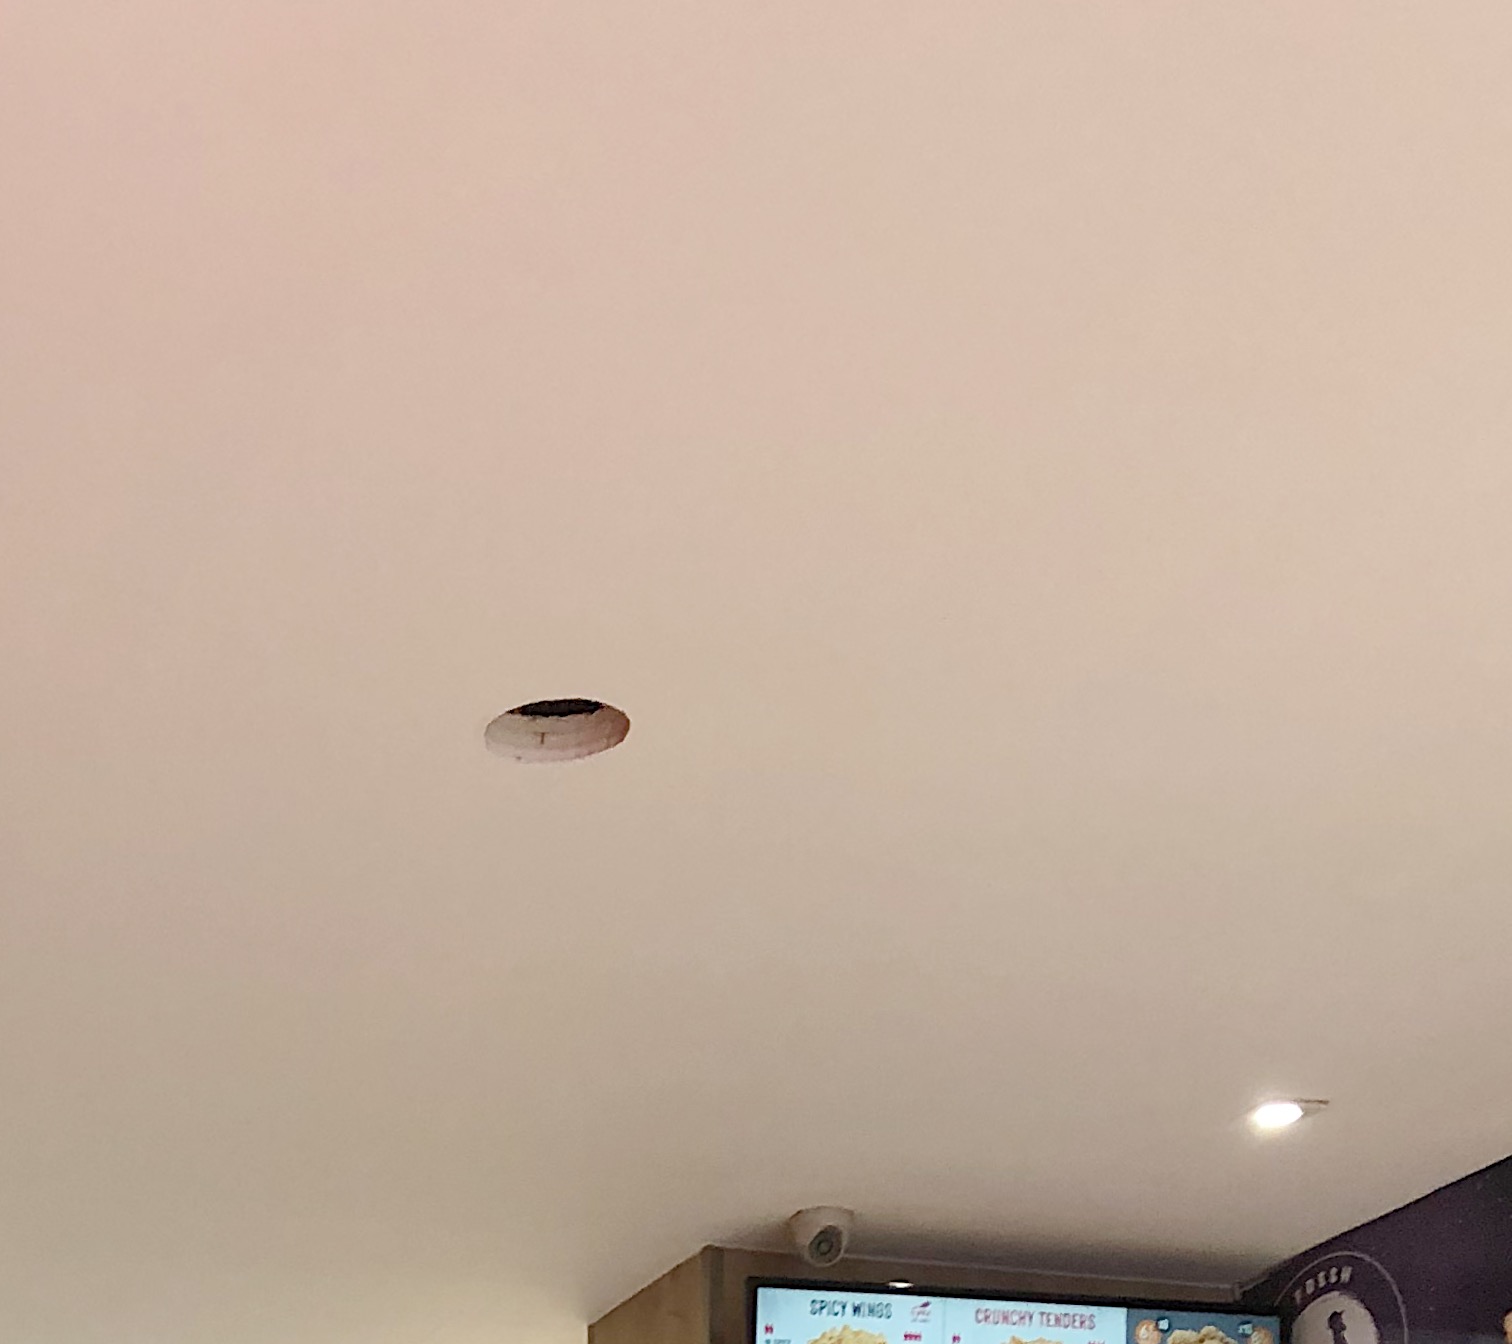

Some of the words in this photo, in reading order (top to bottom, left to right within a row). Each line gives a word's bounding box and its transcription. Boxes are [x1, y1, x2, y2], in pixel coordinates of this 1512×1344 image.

[809, 1300, 847, 1317] SPICY
[851, 1302, 893, 1320] WINGS
[974, 1308, 1034, 1327] CRUNCHY
[1038, 1312, 1097, 1331] TENDERS
